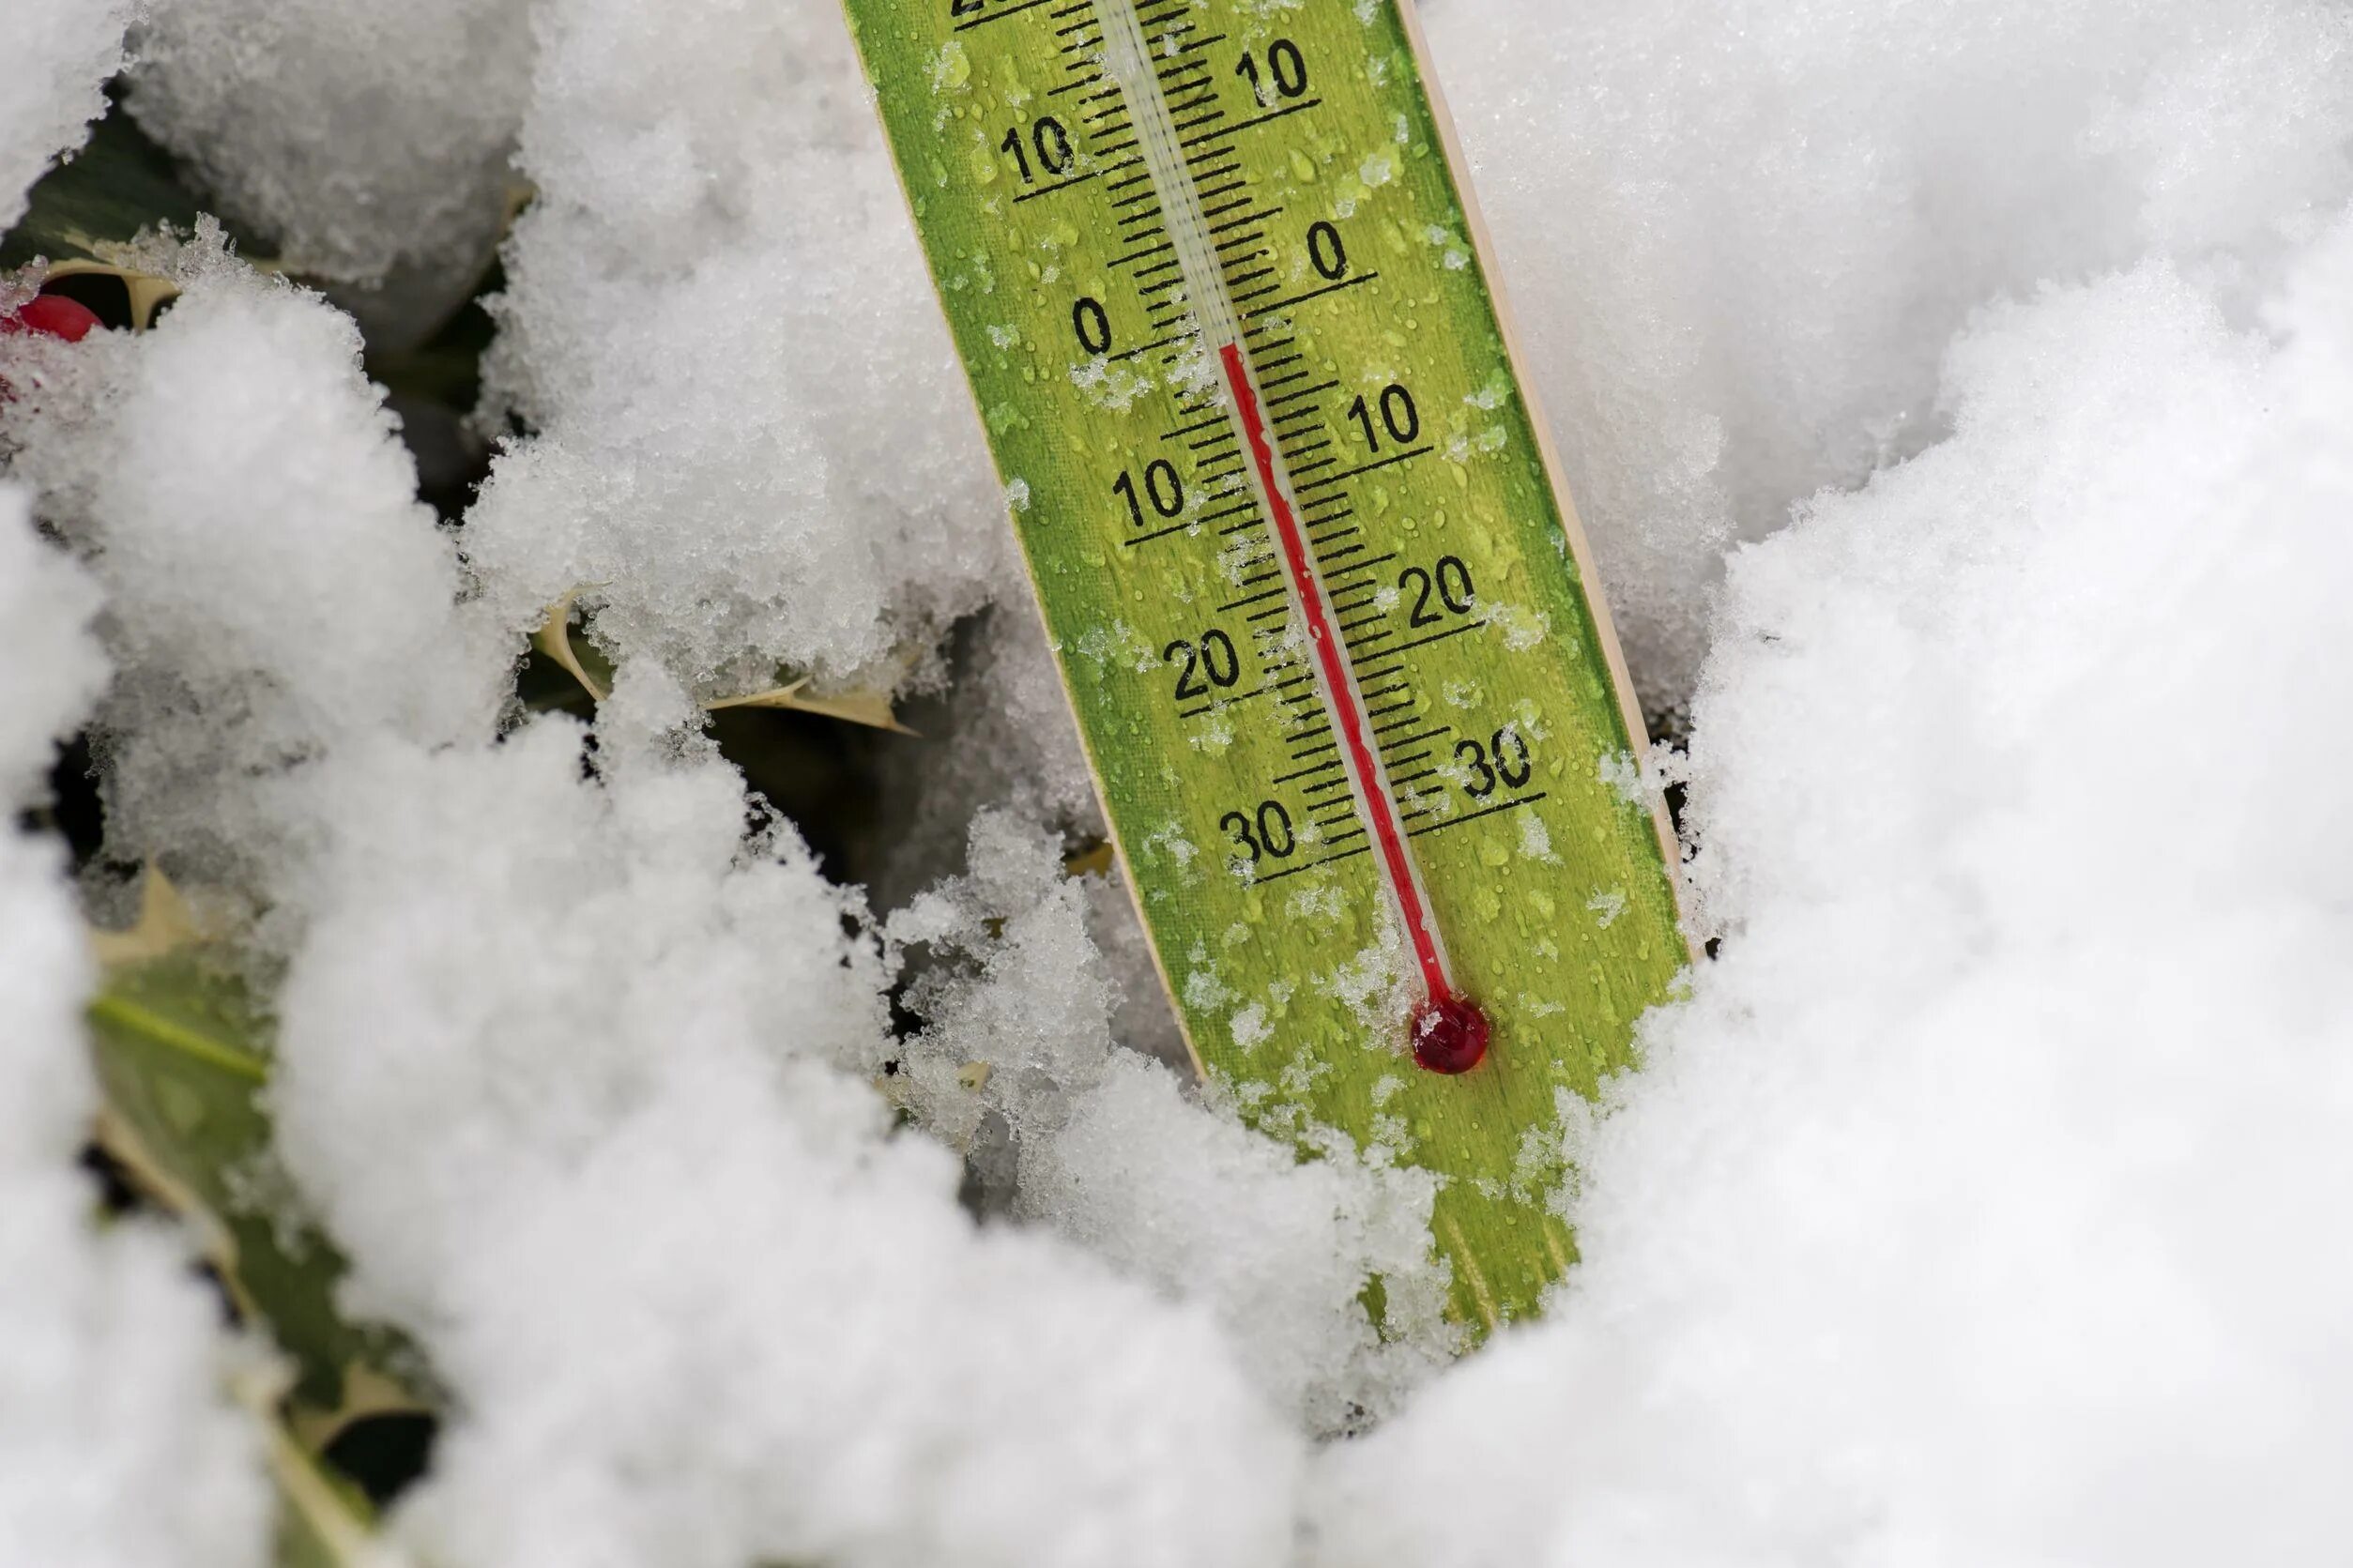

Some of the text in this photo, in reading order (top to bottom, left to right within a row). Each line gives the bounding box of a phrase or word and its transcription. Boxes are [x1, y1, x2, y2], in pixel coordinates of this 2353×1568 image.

[1236, 38, 1307, 108] 10
[1001, 115, 1074, 184] 10
[1306, 221, 1347, 281] 0
[1073, 297, 1112, 355] 0
[1347, 383, 1419, 454] 10
[1112, 458, 1184, 527] 10
[1398, 555, 1474, 630] 20
[1163, 629, 1240, 701] 20
[1455, 729, 1531, 799] 30
[1220, 799, 1296, 870] 30
